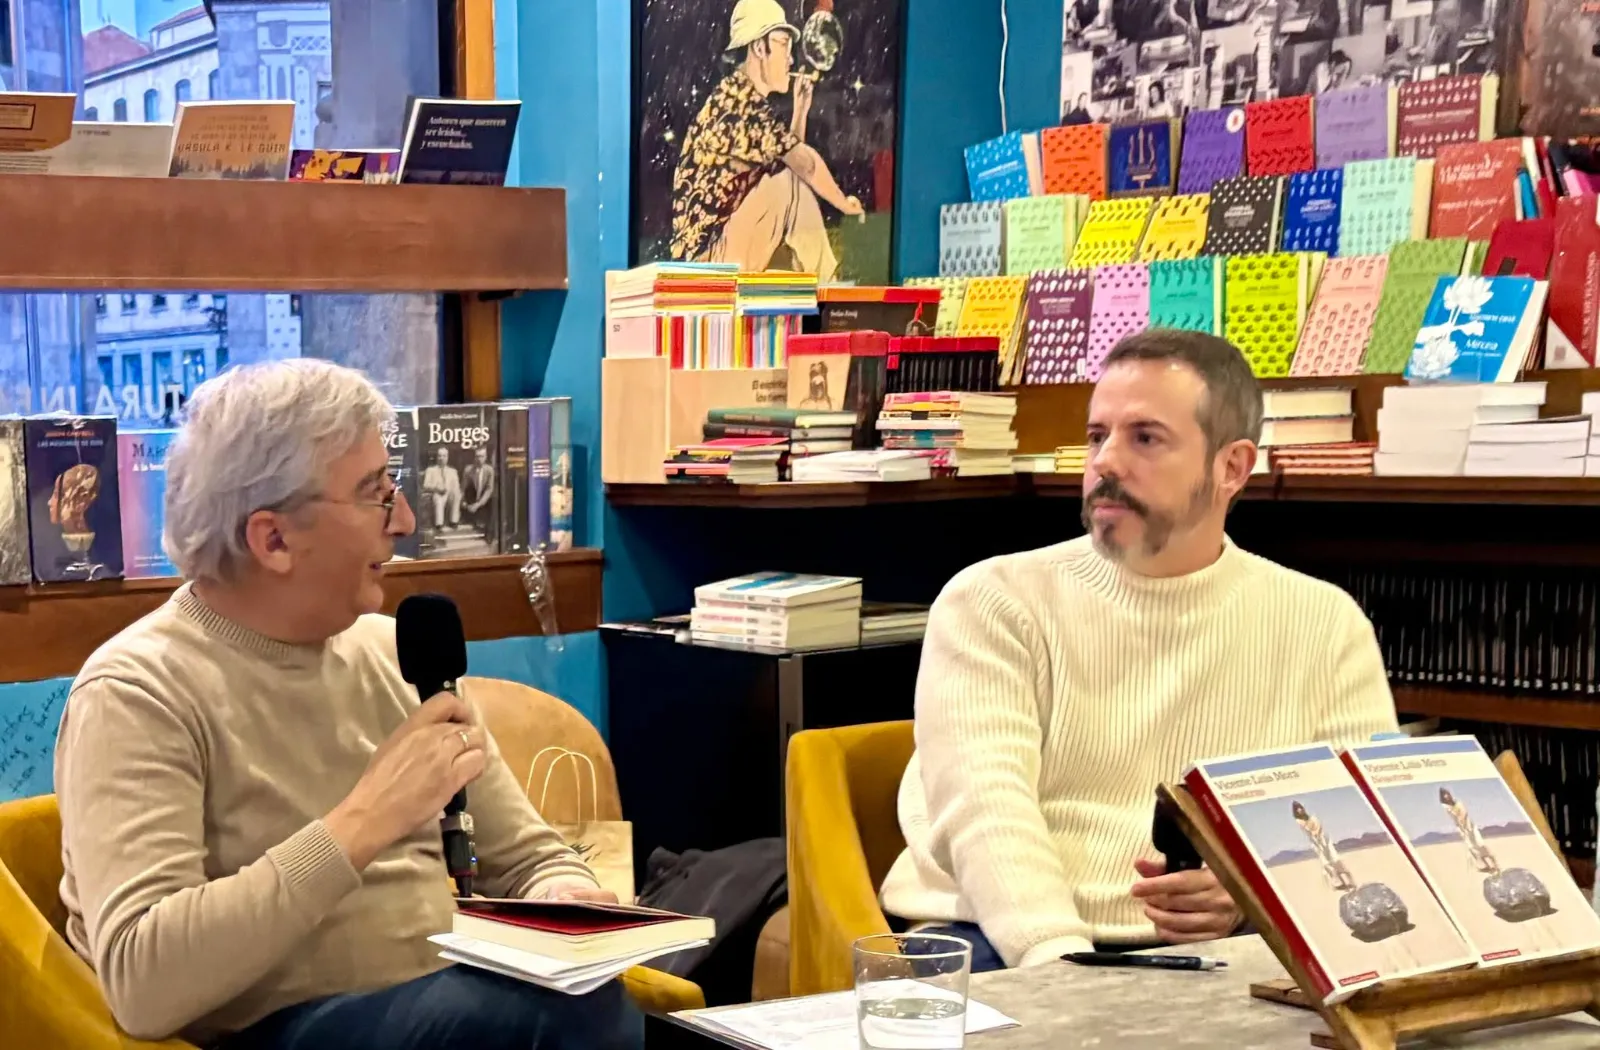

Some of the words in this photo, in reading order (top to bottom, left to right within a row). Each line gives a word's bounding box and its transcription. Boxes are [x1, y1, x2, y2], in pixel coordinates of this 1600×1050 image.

[428, 422, 490, 450] Borges
[1213, 777, 1252, 790] Vicente
[1273, 770, 1300, 781] Mora
